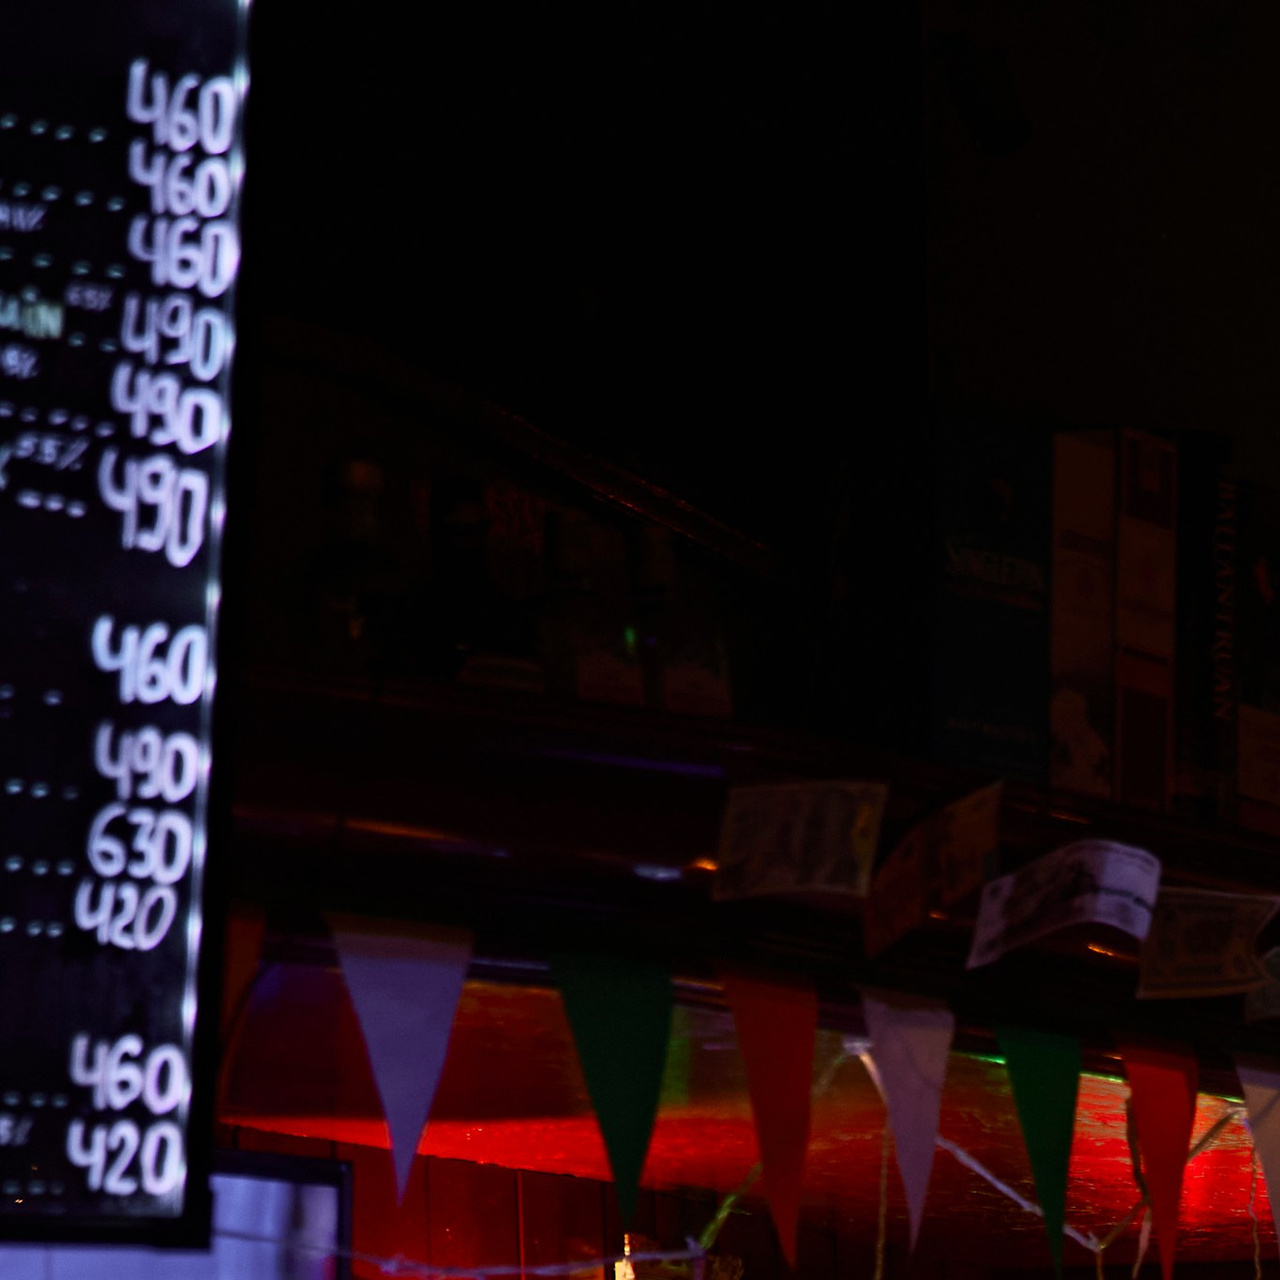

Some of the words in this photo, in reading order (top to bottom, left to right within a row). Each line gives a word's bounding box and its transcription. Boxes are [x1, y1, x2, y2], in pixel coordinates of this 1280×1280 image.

[126, 55, 237, 154] 460
[128, 138, 231, 218] 460
[127, 212, 239, 297] 460
[120, 290, 228, 382] 490
[109, 358, 221, 454] 490
[99, 445, 209, 568] 490
[91, 614, 209, 704] 460
[93, 719, 198, 802] 490
[87, 802, 194, 884] 630
[75, 877, 177, 951] 420
[69, 1031, 189, 1115] 460
[66, 1117, 184, 1197] 420
